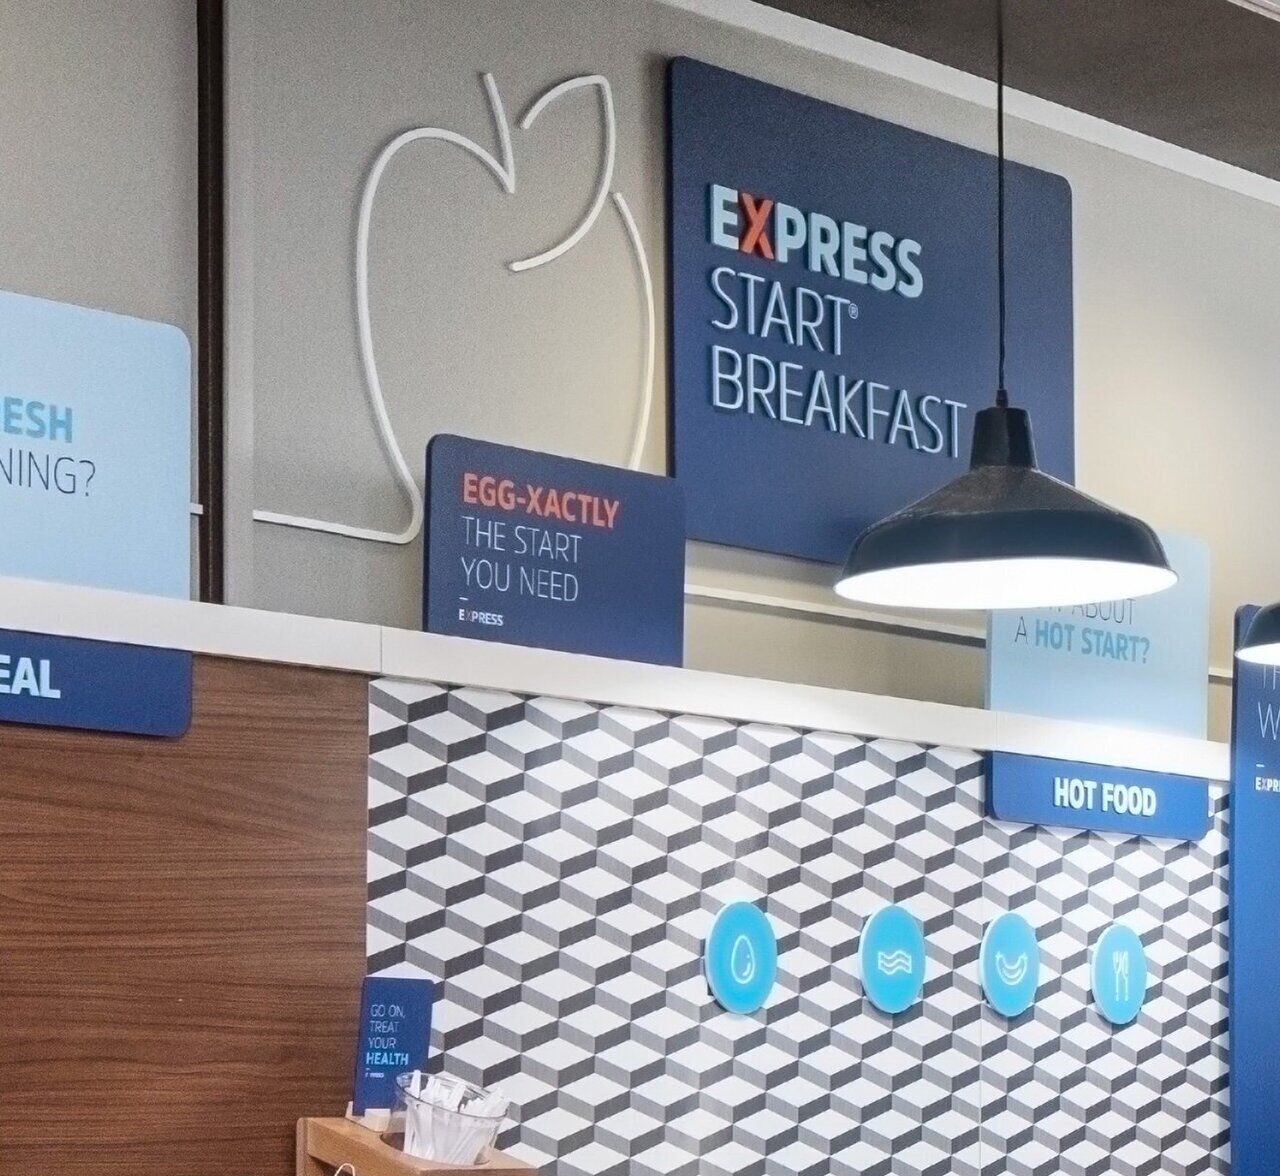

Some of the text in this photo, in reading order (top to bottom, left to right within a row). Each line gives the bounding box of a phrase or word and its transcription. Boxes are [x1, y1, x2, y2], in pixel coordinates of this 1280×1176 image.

[710, 183, 924, 300] EXPRESS
[710, 344, 969, 460] BREAKFAST
[463, 472, 620, 529] EGG-XACTLY
[461, 515, 583, 564] THE START
[460, 556, 579, 602] YOU NEED
[1013, 615, 1151, 665] A HOT START?
[1054, 776, 1157, 818] HOT FOOD
[370, 1004, 386, 1018] GO
[370, 1020, 401, 1033] TREAT
[365, 1052, 409, 1066] HEALTH
[368, 1036, 397, 1049] YOUR
